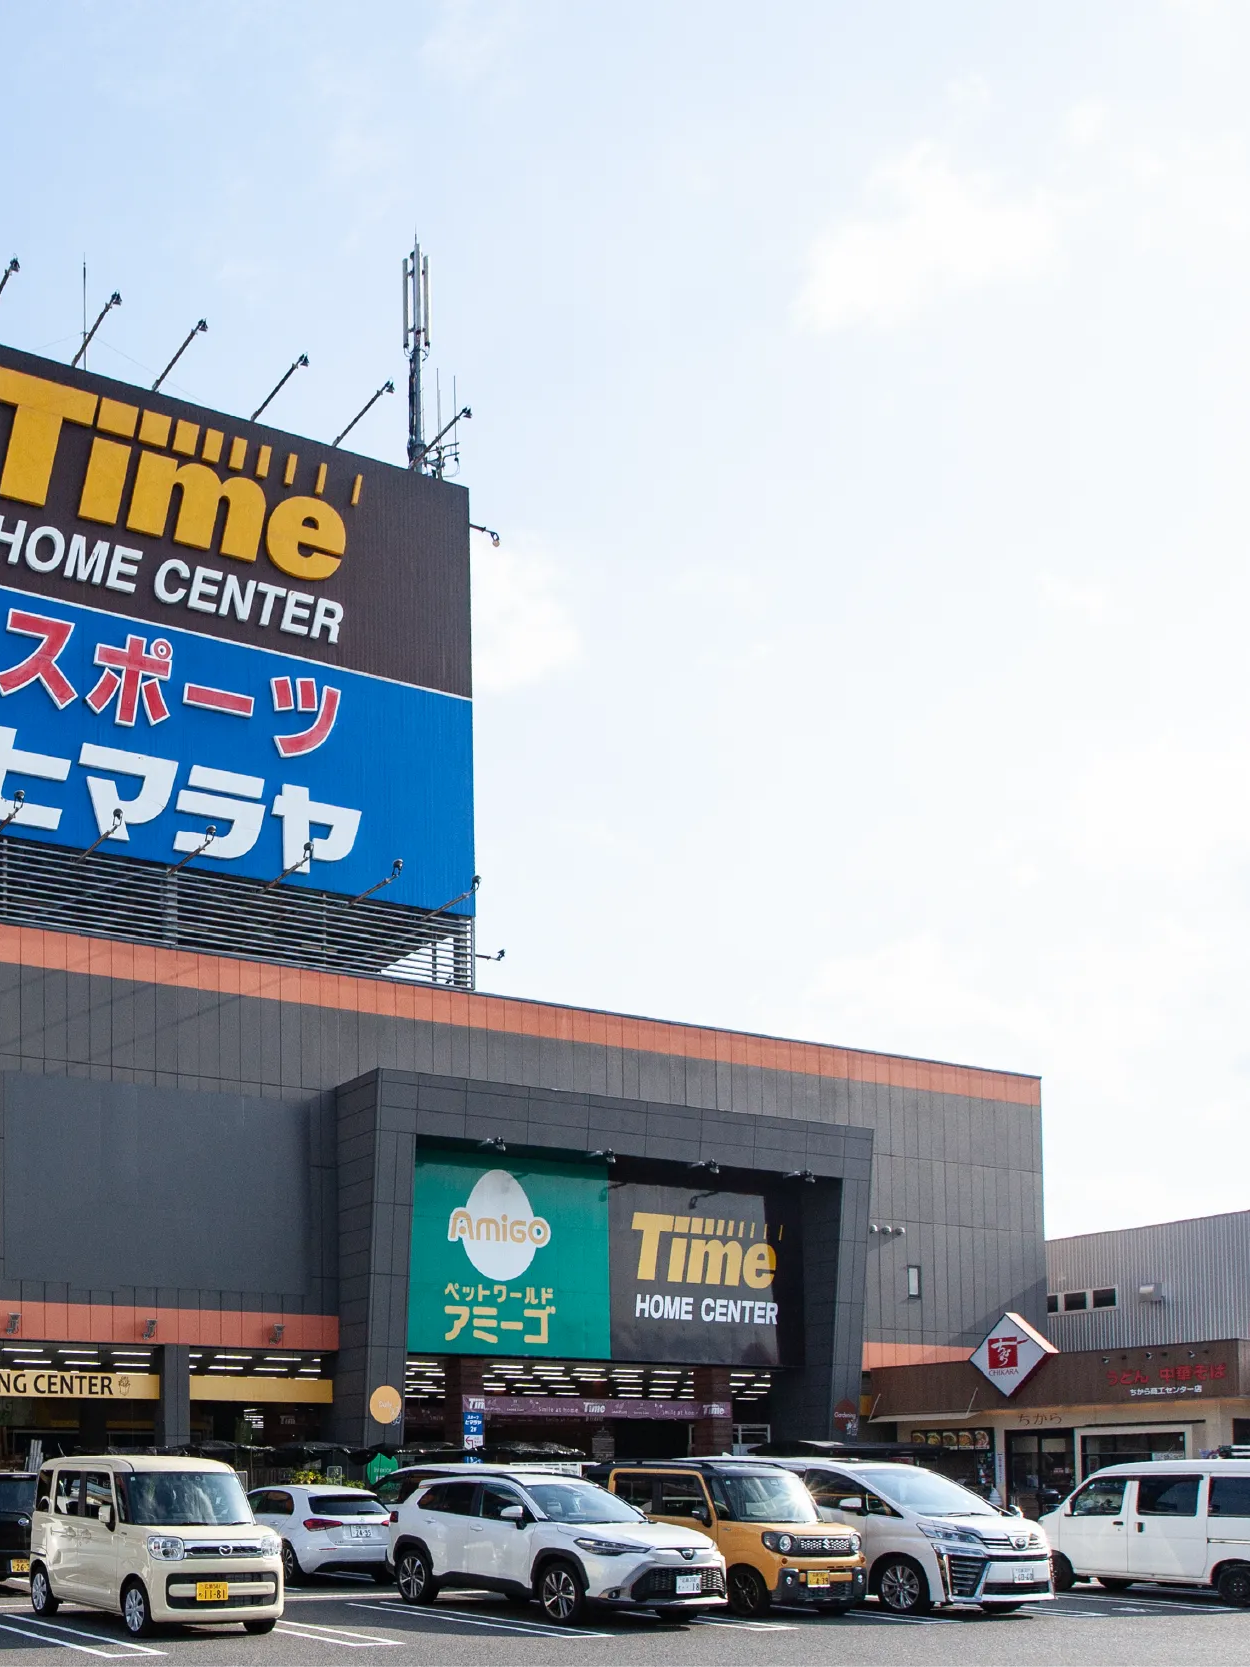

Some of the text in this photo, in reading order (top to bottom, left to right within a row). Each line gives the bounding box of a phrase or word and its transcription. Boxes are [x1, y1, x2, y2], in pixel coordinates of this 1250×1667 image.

[154, 558, 344, 644] CENTER
[631, 1211, 783, 1288] Time
[445, 1283, 554, 1304] ペットワールド
[635, 1294, 778, 1325] HOME CENTER
[445, 1306, 556, 1343] アミーゴ
[33, 1374, 113, 1395] CENTER
[1106, 1363, 1227, 1386] うどん 中華そば
[1130, 1385, 1202, 1396] ちから商工センター店
[583, 1402, 605, 1413] Time
[703, 1403, 725, 1415] Time
[1018, 1413, 1063, 1426] ちから
[204, 1590, 224, 1599] 11-81
